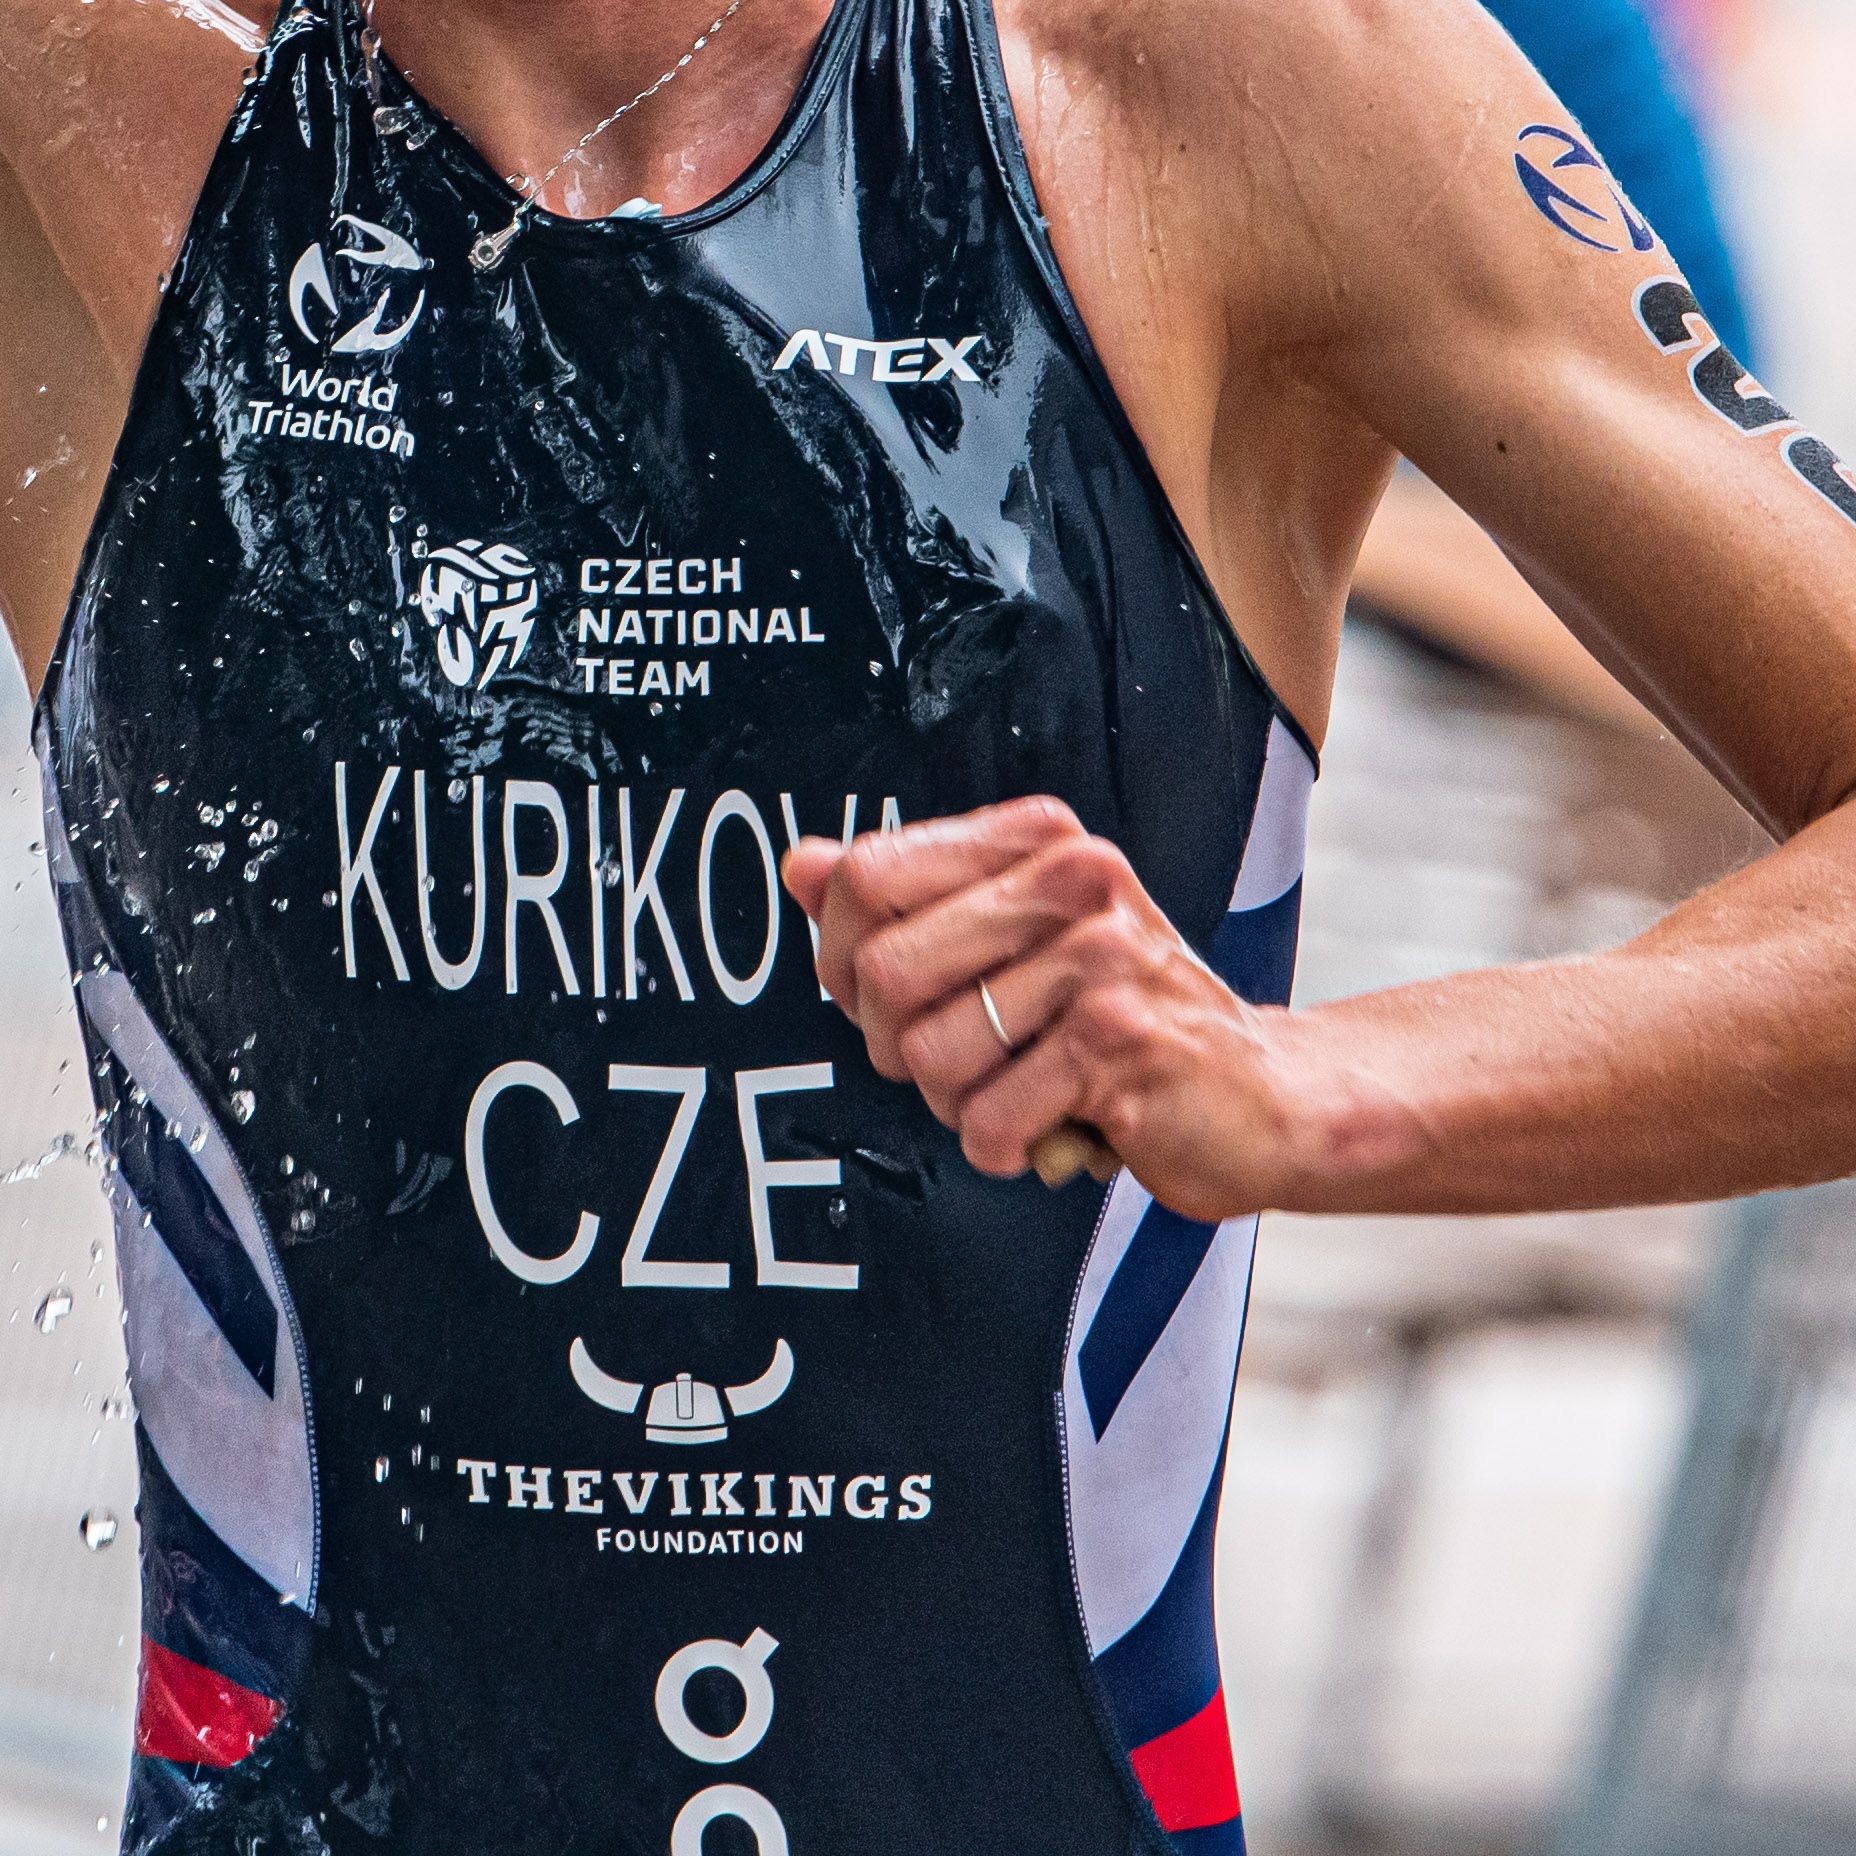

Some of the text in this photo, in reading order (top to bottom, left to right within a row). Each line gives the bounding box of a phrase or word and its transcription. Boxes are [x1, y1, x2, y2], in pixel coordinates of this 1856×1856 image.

[772, 328, 983, 383] ATEX
[282, 363, 399, 412] World
[247, 401, 415, 457] Triathlon
[580, 557, 742, 595] CZECH
[578, 607, 825, 647] NATIONAL
[575, 657, 710, 696] TEAM
[335, 761, 902, 1005] KURIKO
[465, 1060, 860, 1289] CZE
[456, 1458, 933, 1521] THEVIKINGS
[595, 1527, 804, 1555] FOUNDATION
